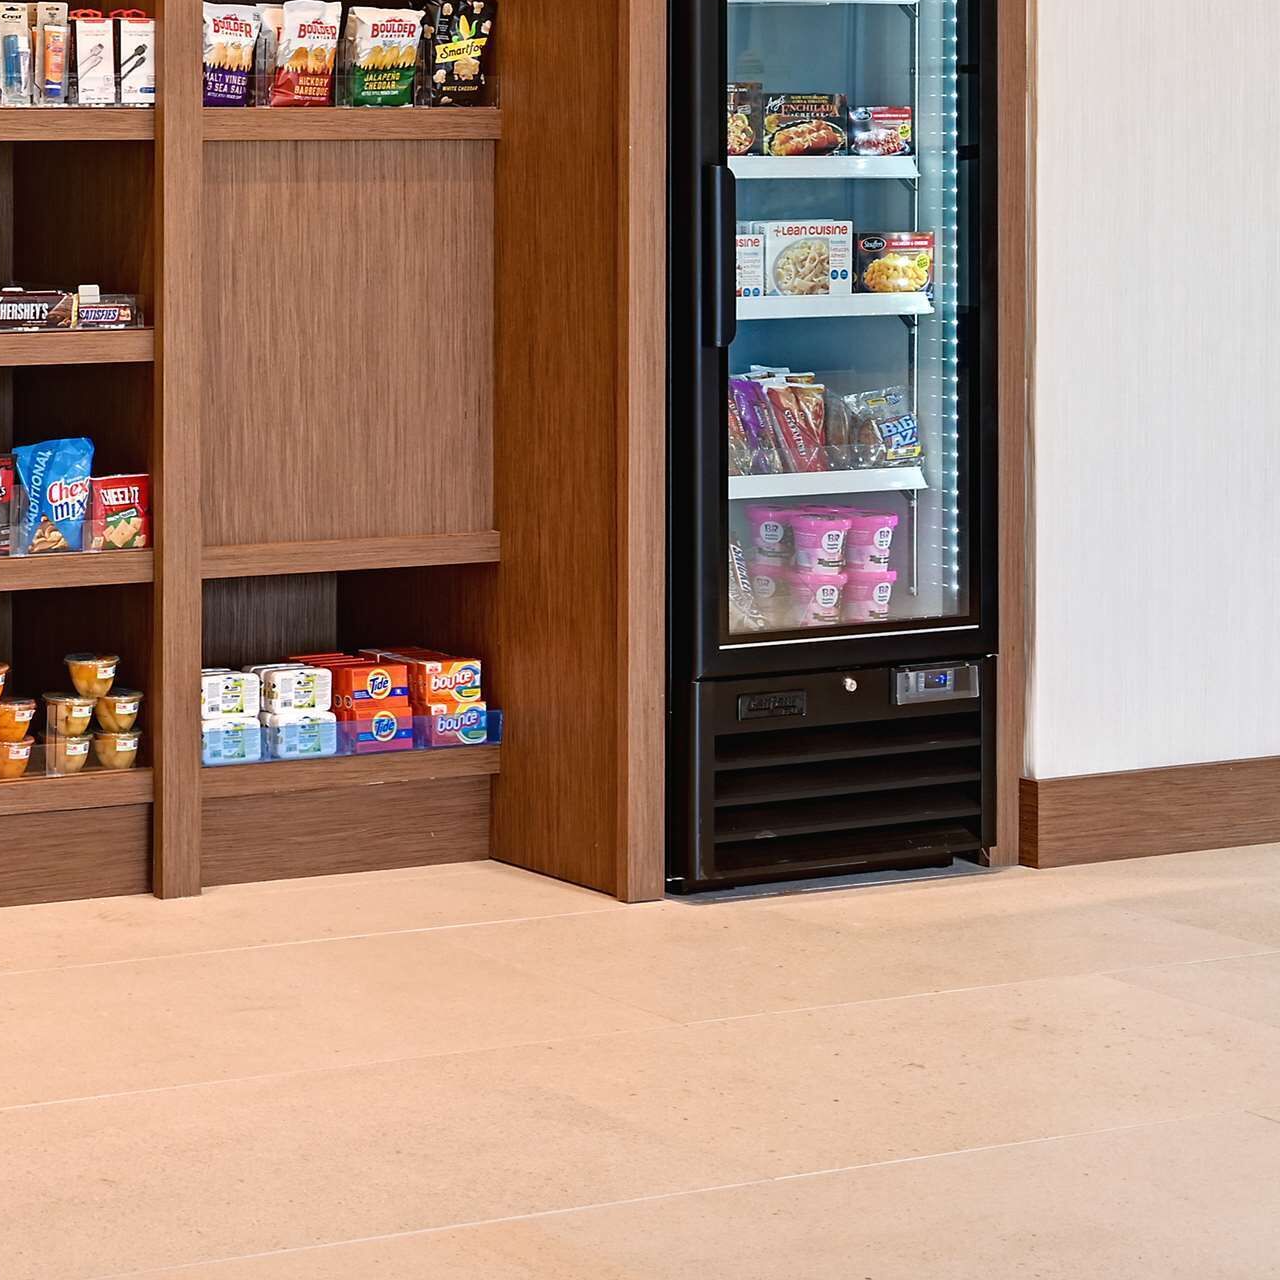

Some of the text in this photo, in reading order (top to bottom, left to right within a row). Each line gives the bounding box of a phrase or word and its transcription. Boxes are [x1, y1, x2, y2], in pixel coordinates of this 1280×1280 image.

[213, 18, 253, 38] BOULDER
[371, 23, 416, 38] BOULDER
[214, 84, 228, 92] SEA
[299, 77, 329, 87] HICKORY
[364, 81, 396, 90] CHEDDAR
[294, 86, 329, 96] BARBEQUE
[0, 303, 49, 320] HERSHEY'S
[79, 309, 118, 321] SATISFIES
[879, 415, 917, 437] BIG
[891, 430, 916, 449] AZ
[48, 481, 89, 503] Chex
[54, 500, 87, 521] mix
[370, 677, 389, 694] Tide
[431, 671, 473, 691] bounce
[375, 720, 395, 737] Tide
[438, 711, 479, 732] bounce
